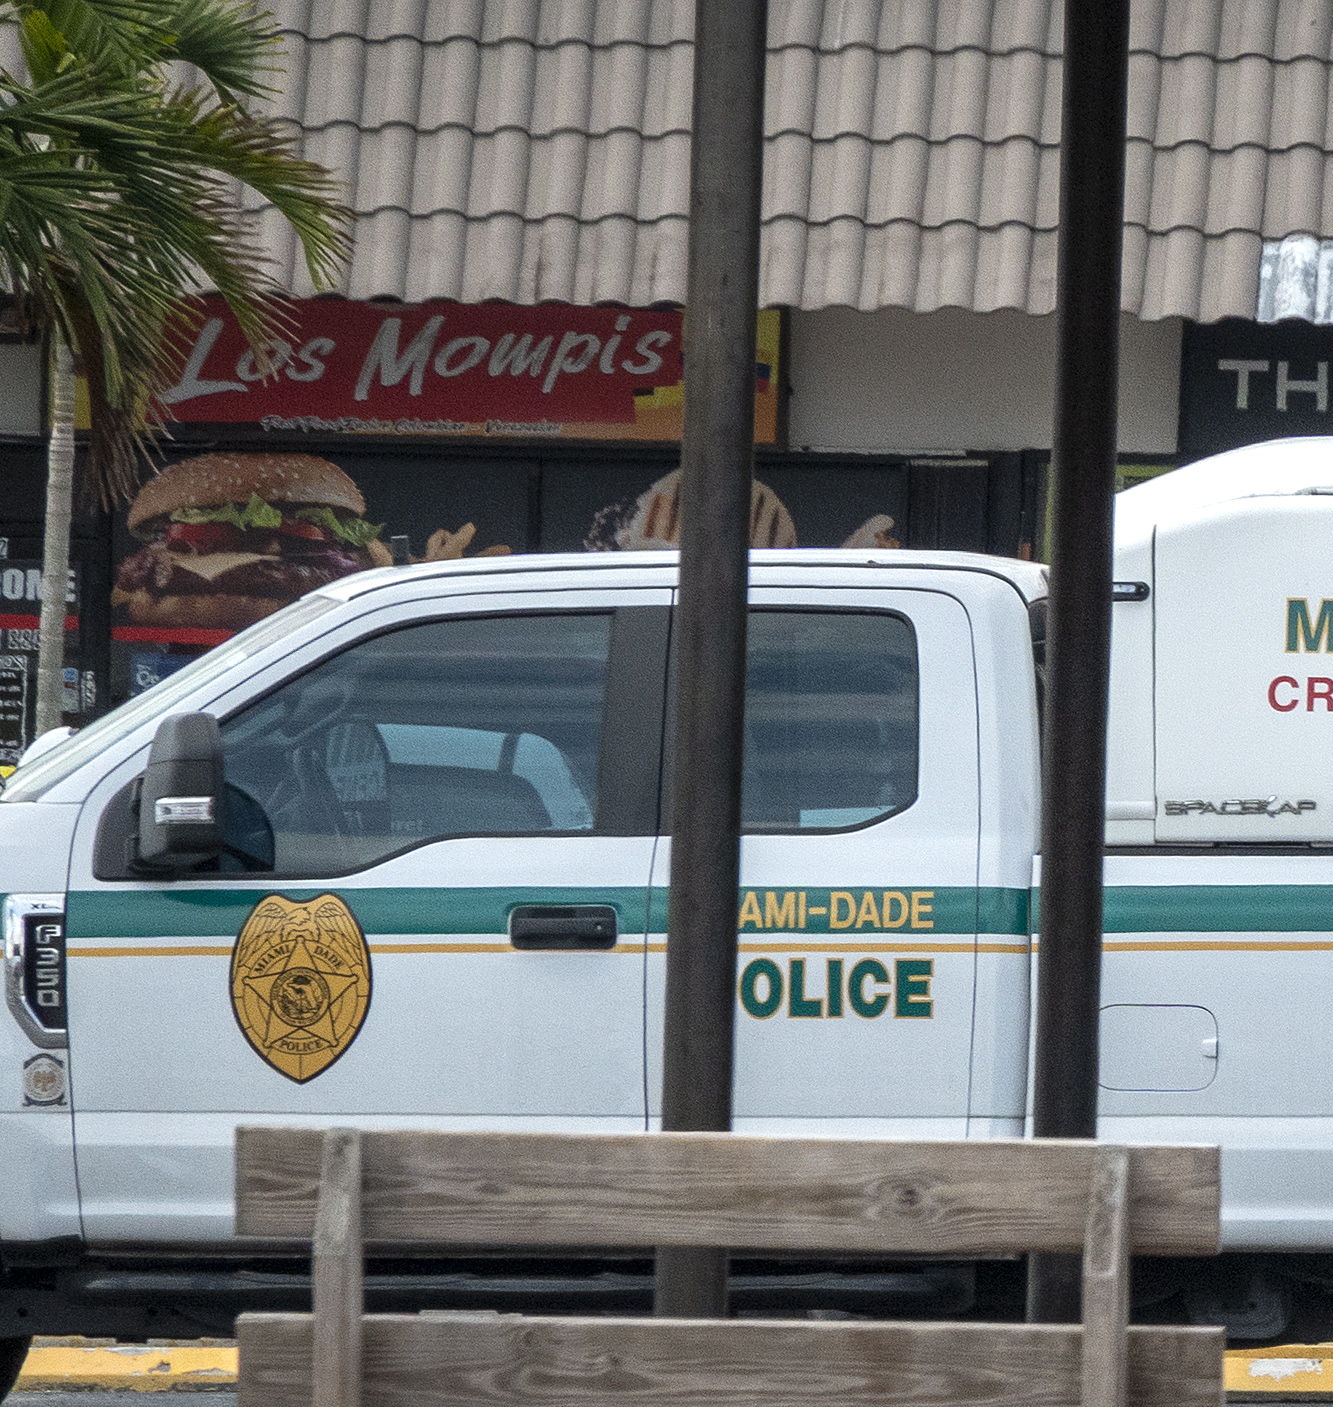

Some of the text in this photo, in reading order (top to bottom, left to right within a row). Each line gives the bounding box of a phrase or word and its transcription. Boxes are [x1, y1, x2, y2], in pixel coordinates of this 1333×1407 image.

[161, 314, 673, 404] Los Mompis
[739, 890, 934, 929] AMI-DADE
[254, 944, 346, 973] MIAMI DADE
[739, 957, 934, 1020] OLICE
[280, 1039, 323, 1051] POLICE
